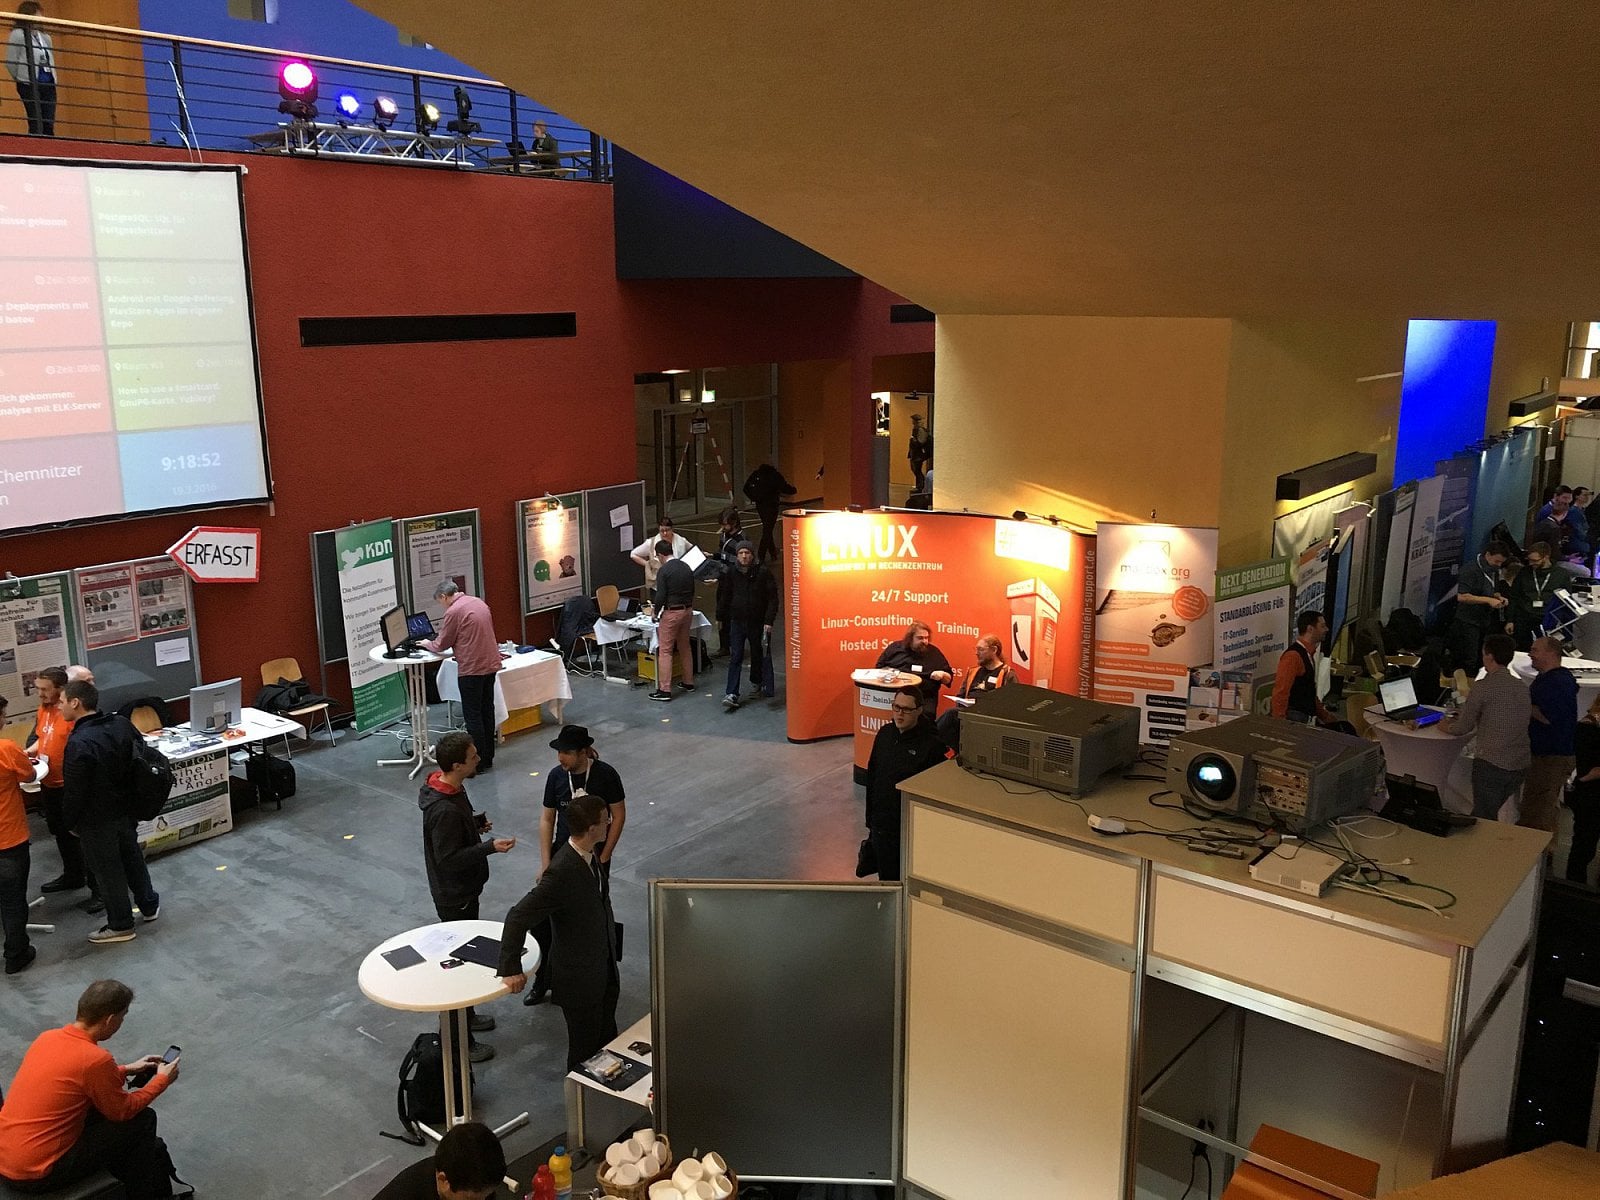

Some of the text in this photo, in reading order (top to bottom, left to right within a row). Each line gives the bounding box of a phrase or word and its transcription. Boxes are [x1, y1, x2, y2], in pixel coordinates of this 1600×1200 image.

[6, 302, 71, 312] Deployments
[73, 301, 89, 310] mit
[0, 406, 32, 417] nalyse
[34, 404, 53, 413] mit
[161, 452, 222, 472] 9:18:52
[820, 524, 919, 561] LINUX
[185, 542, 255, 567] ERFASST
[878, 561, 943, 571] RECHENZENTRUM
[1220, 572, 1241, 589] NEXT
[1241, 561, 1286, 583] GENERATION
[790, 529, 802, 669] http://www.heinlein-support.de
[871, 589, 949, 605] 24/7 Support
[936, 621, 980, 638] Training
[1222, 627, 1249, 641] IT-Service
[840, 639, 879, 652] Hosted
[172, 763, 214, 778] eiheit
[186, 773, 225, 791] Angst
